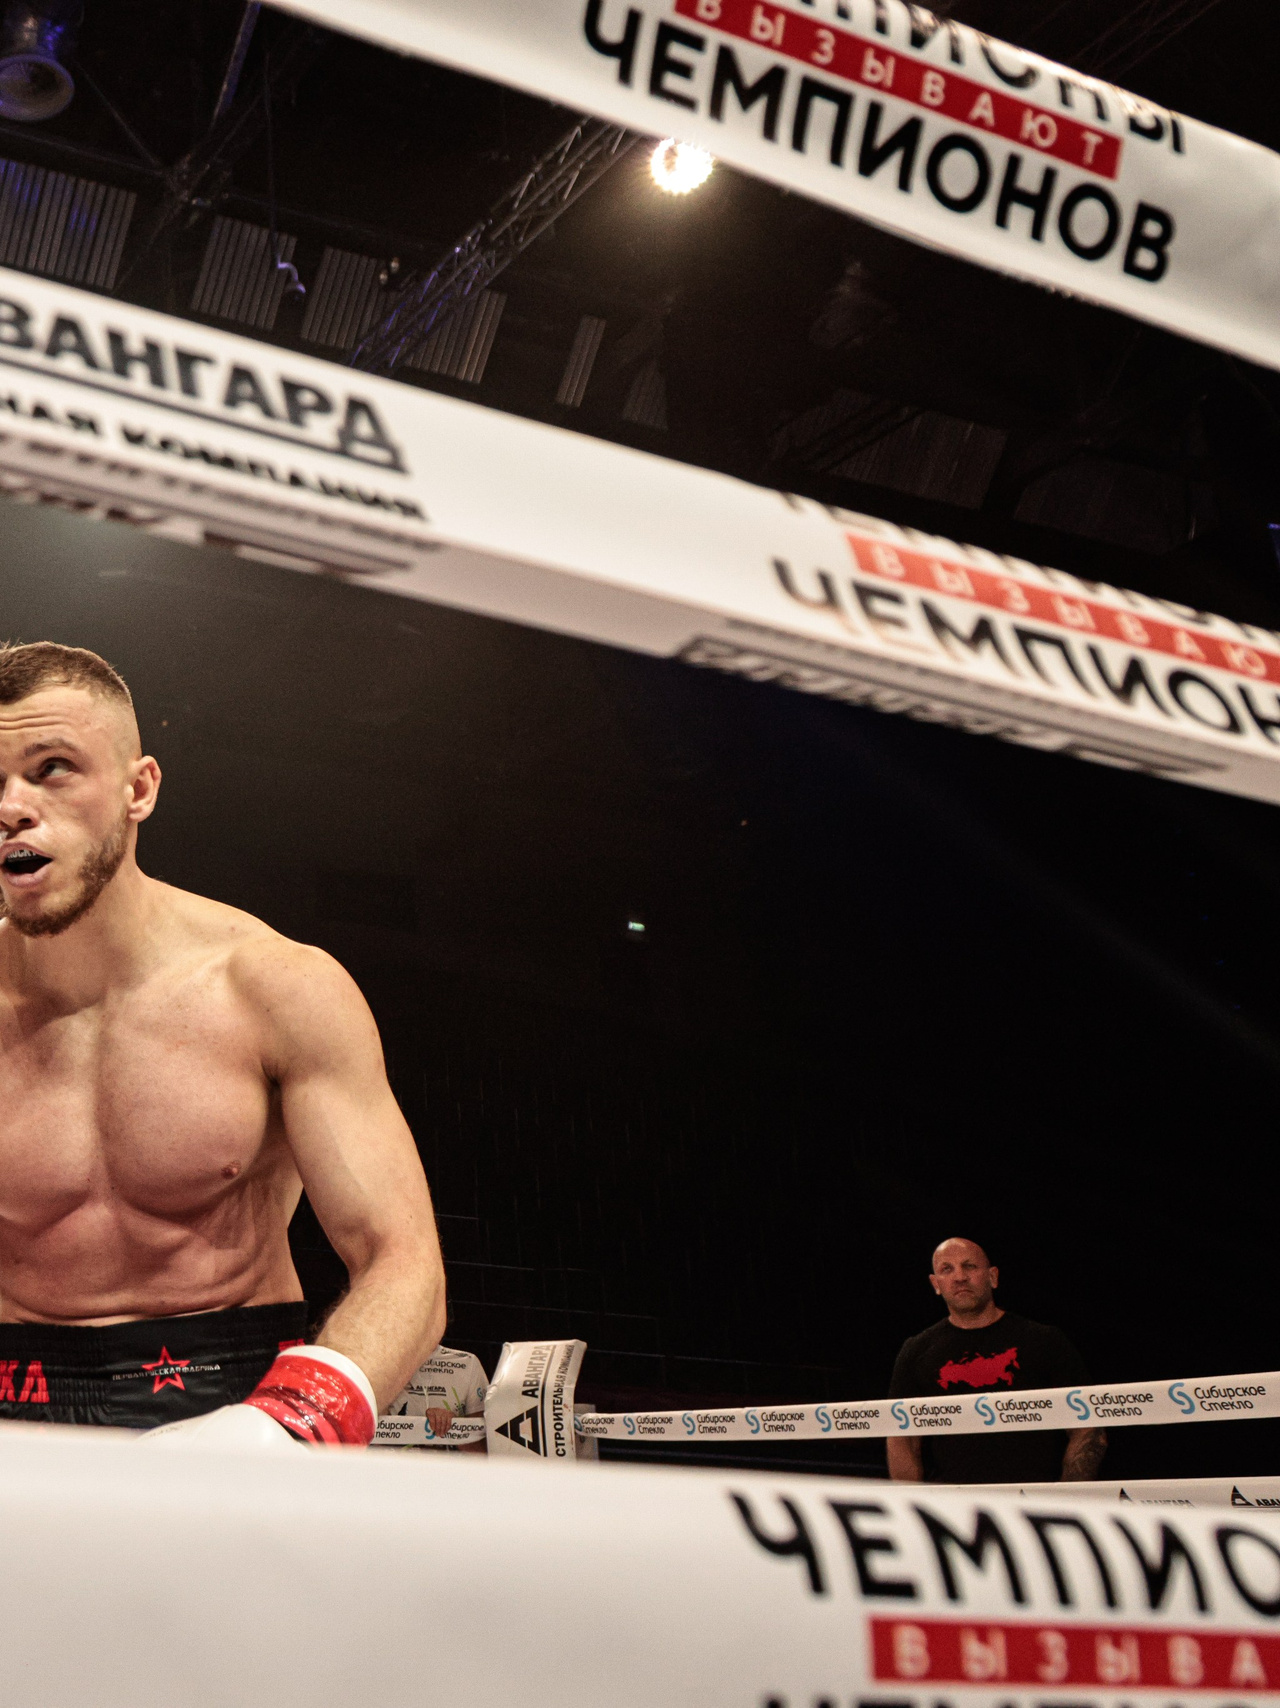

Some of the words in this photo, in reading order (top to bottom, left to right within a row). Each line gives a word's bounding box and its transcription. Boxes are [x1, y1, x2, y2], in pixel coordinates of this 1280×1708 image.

[584, 0, 1176, 283] ЧЕМПИОНОВ
[522, 1344, 553, 1398] АВАНГАРД
[1194, 1384, 1266, 1401] Сибирское
[994, 1398, 1053, 1412] Сибирское
[1089, 1391, 1154, 1407] Сибирское
[910, 1404, 962, 1417] Сибирское
[1200, 1399, 1254, 1412] Стекло
[553, 1373, 566, 1457] СТРОИТЕЛЬНАЯ
[761, 1411, 805, 1423] Сибирское
[832, 1407, 880, 1420] Сибирское
[999, 1411, 1042, 1424] Стекло
[1094, 1406, 1142, 1418] Стекло
[377, 1420, 414, 1430] бирское
[636, 1414, 674, 1426] Сибирское
[696, 1413, 735, 1425] Сибирское
[835, 1420, 870, 1430] Стекло
[913, 1416, 952, 1428] Стекло
[451, 1422, 484, 1431] бирское
[638, 1425, 666, 1435] Стекло
[698, 1423, 727, 1434] Стекло
[763, 1422, 796, 1432] Стекло
